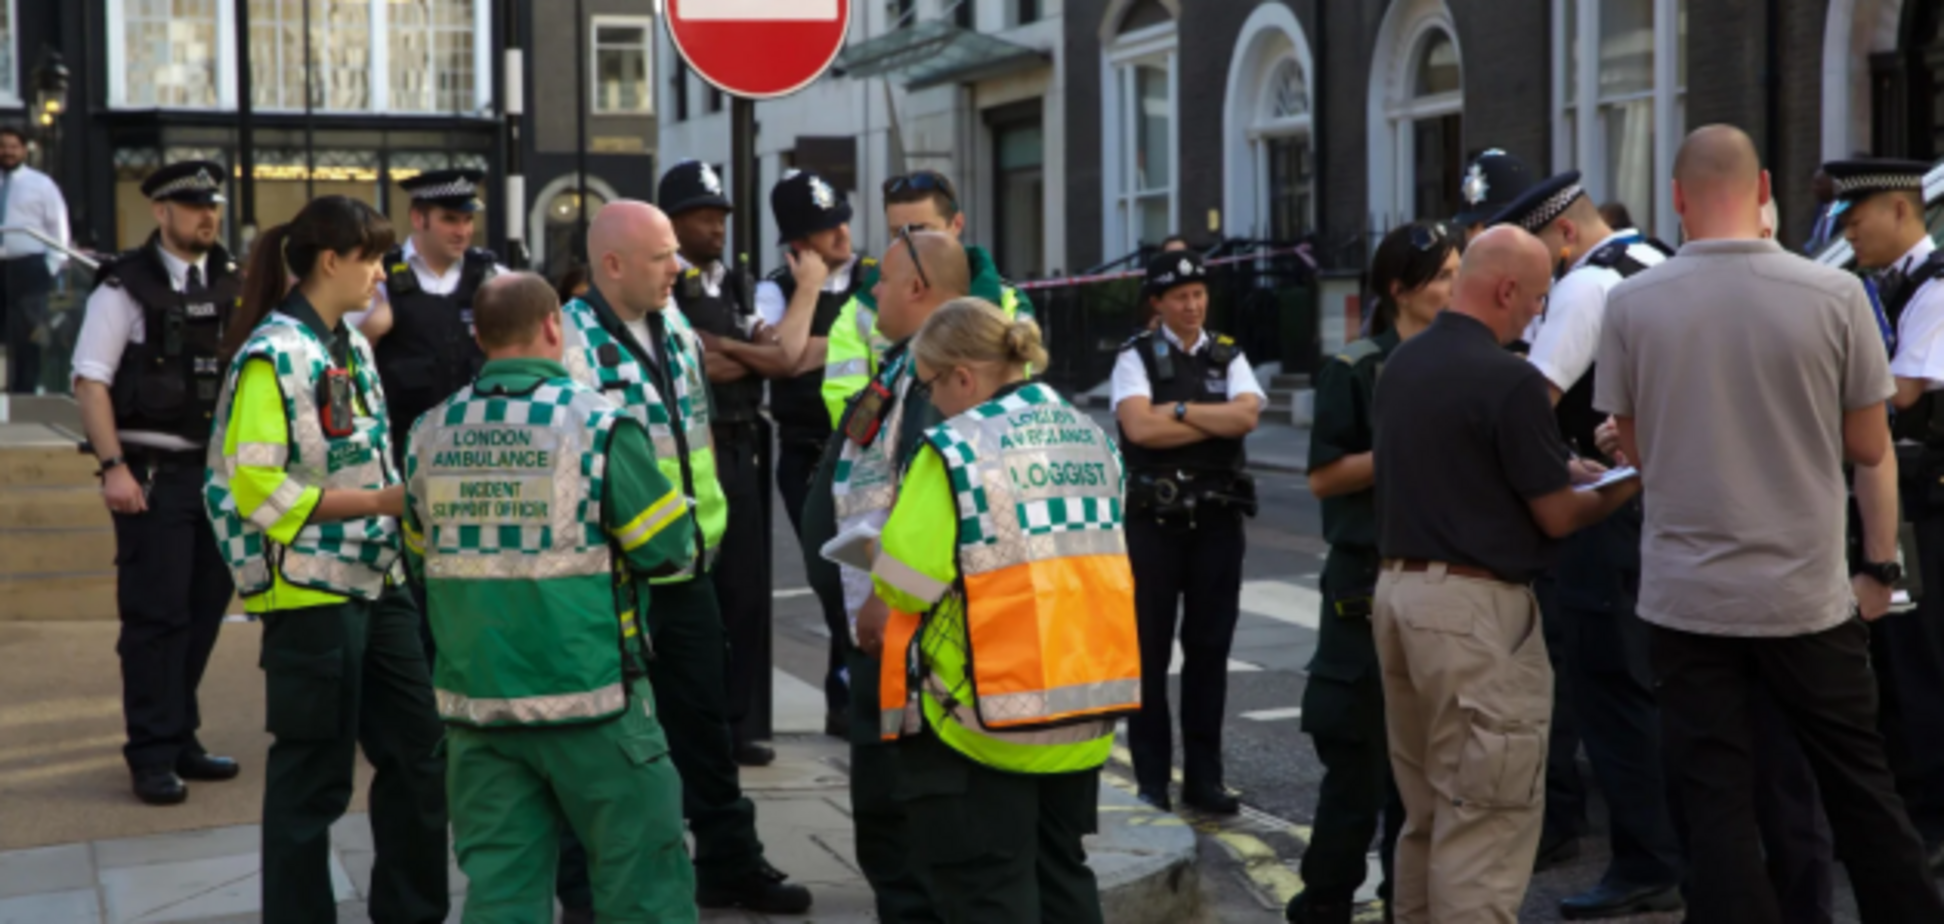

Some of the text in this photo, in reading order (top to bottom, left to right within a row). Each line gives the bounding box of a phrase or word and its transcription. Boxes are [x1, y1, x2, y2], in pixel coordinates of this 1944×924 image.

[453, 429, 532, 446] LONDON
[432, 451, 549, 467] AMBULANCE
[1010, 461, 1107, 489] LOGGIST
[460, 481, 522, 498] INCIDENT
[432, 502, 549, 517] SUPPORT OFFICER
